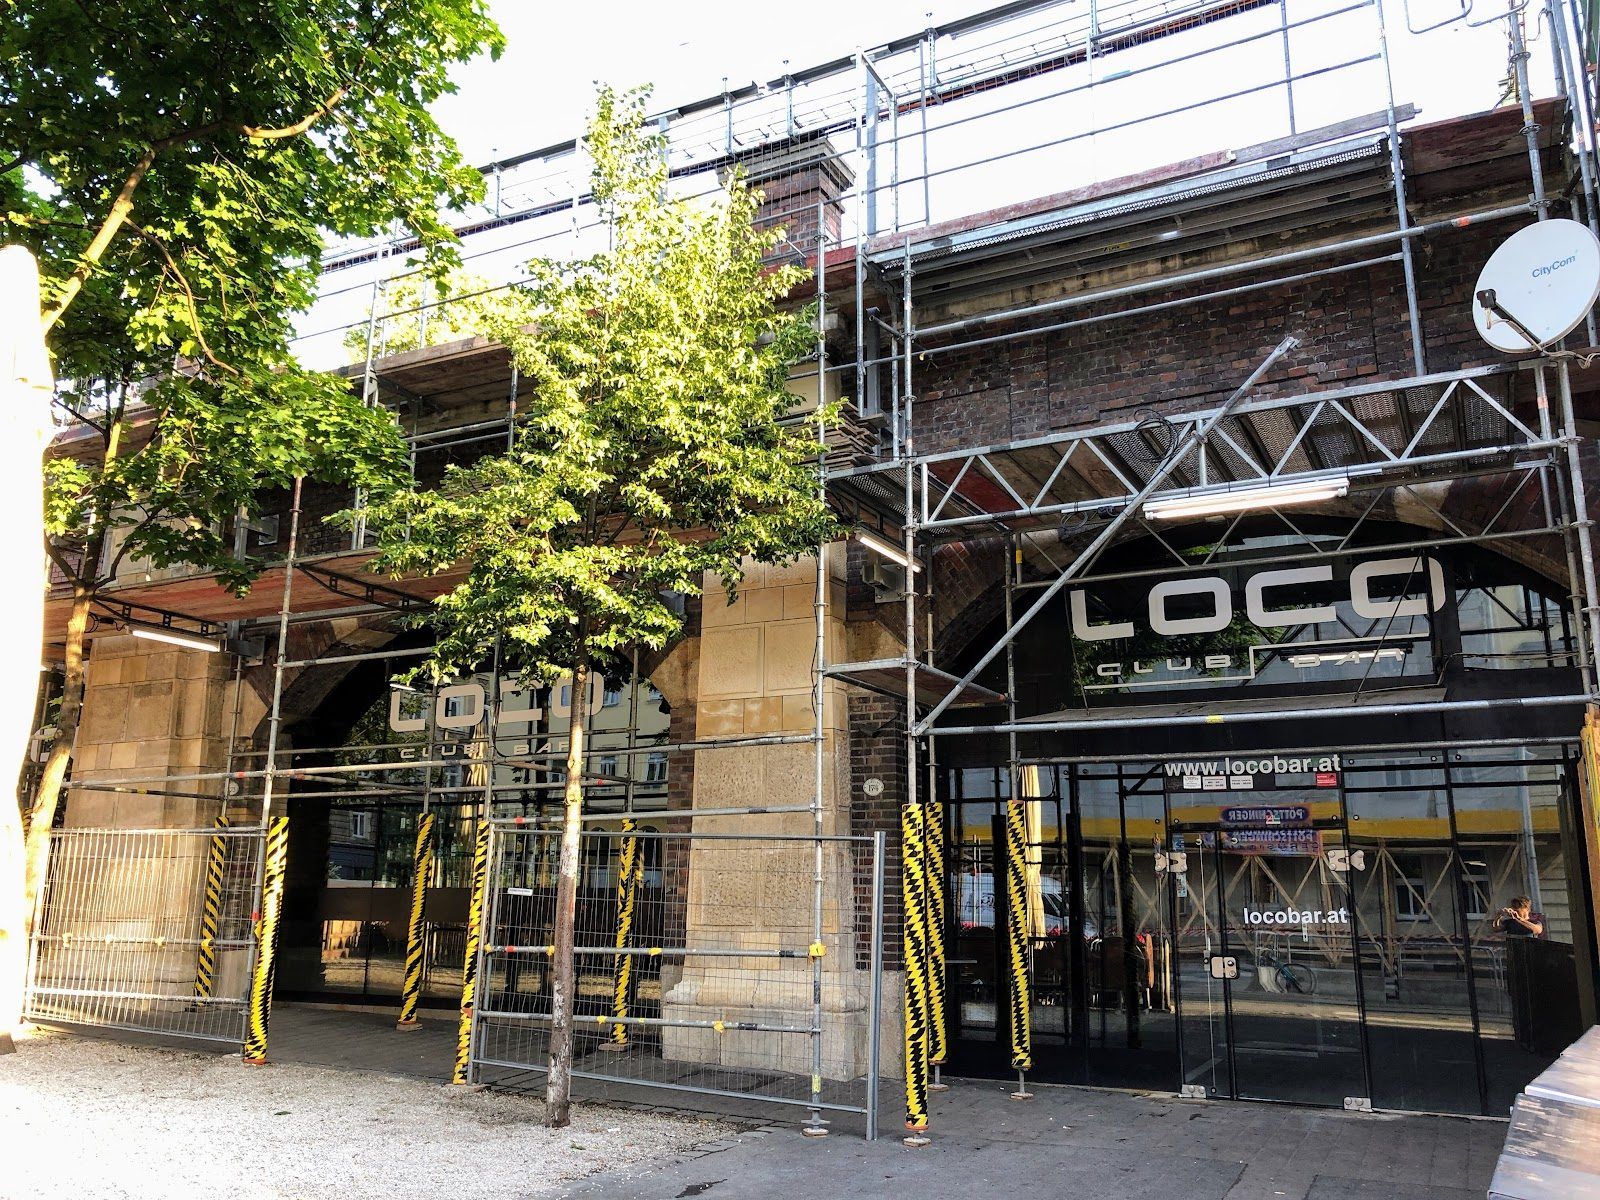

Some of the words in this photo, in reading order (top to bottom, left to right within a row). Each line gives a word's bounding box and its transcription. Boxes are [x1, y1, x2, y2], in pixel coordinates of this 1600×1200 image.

[1532, 255, 1576, 278] CityCom
[1070, 556, 1445, 641] LOCO
[1096, 653, 1232, 676] CLUB
[1292, 648, 1405, 668] BAR
[1164, 755, 1341, 776] www.locobar.at
[1243, 907, 1347, 924] locobar.at
